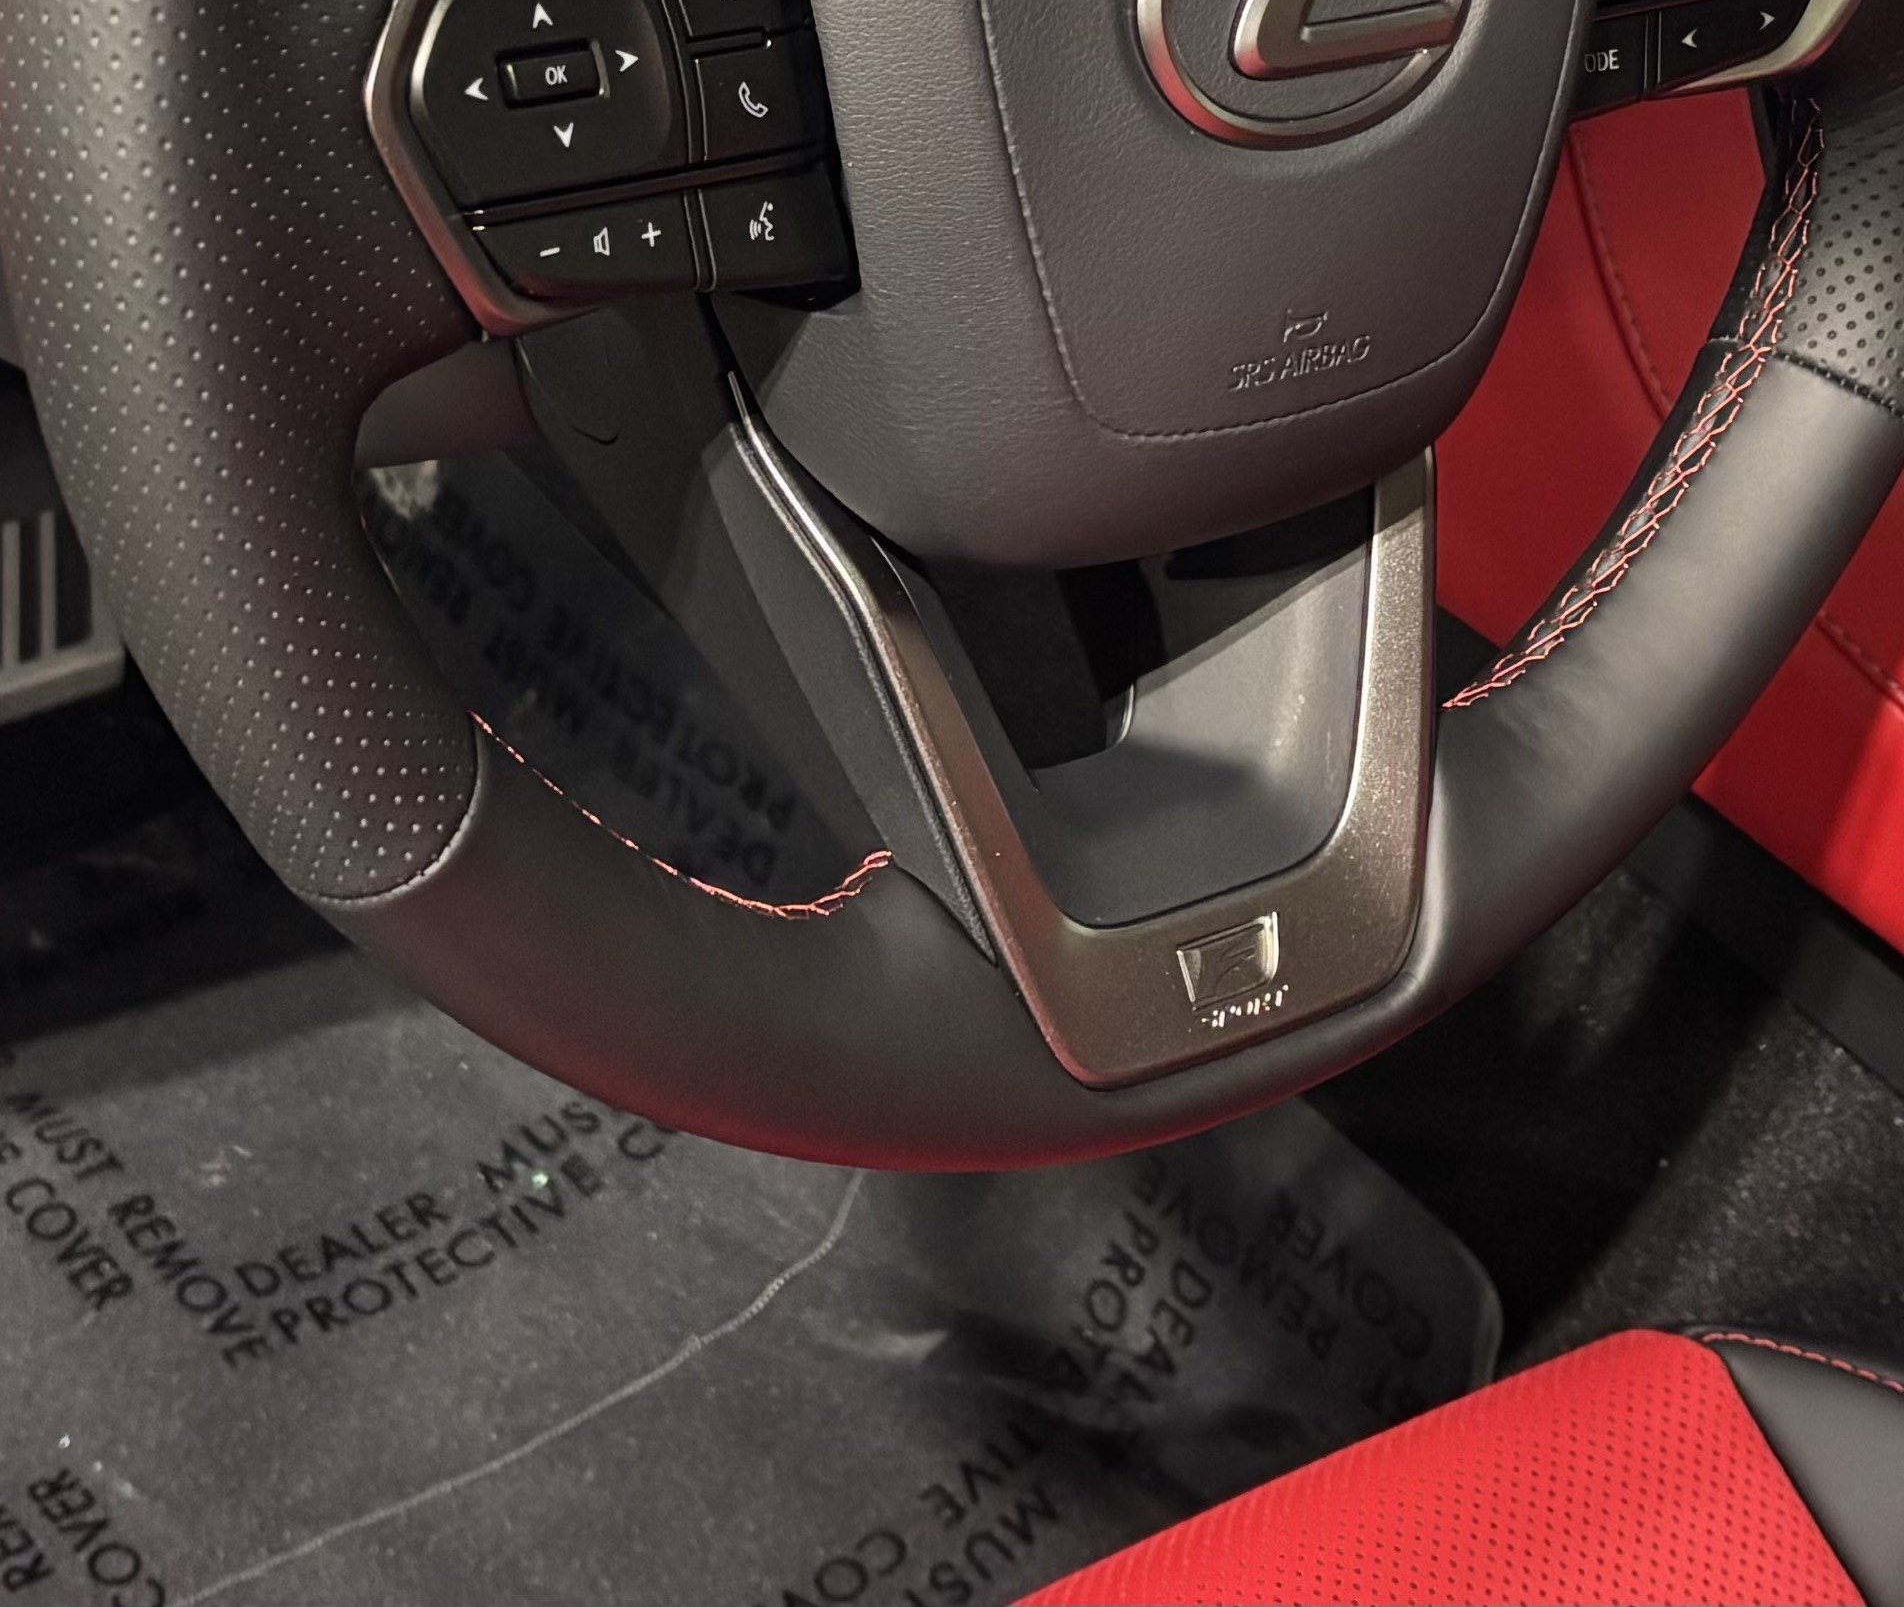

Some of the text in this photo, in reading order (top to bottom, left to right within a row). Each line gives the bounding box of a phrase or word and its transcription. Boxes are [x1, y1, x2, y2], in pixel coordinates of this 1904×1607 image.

[544, 64, 568, 86] OK
[1585, 48, 1620, 73] ODE
[1281, 335, 1372, 379] AIRBAG
[3, 1091, 274, 1371] MUST REMOVE
[4, 1176, 134, 1312] COVER
[234, 1190, 452, 1301] DEALER
[476, 1100, 626, 1194] MUS
[270, 1152, 604, 1348] PROTECTIVE
[26, 1466, 166, 1607] COVER
